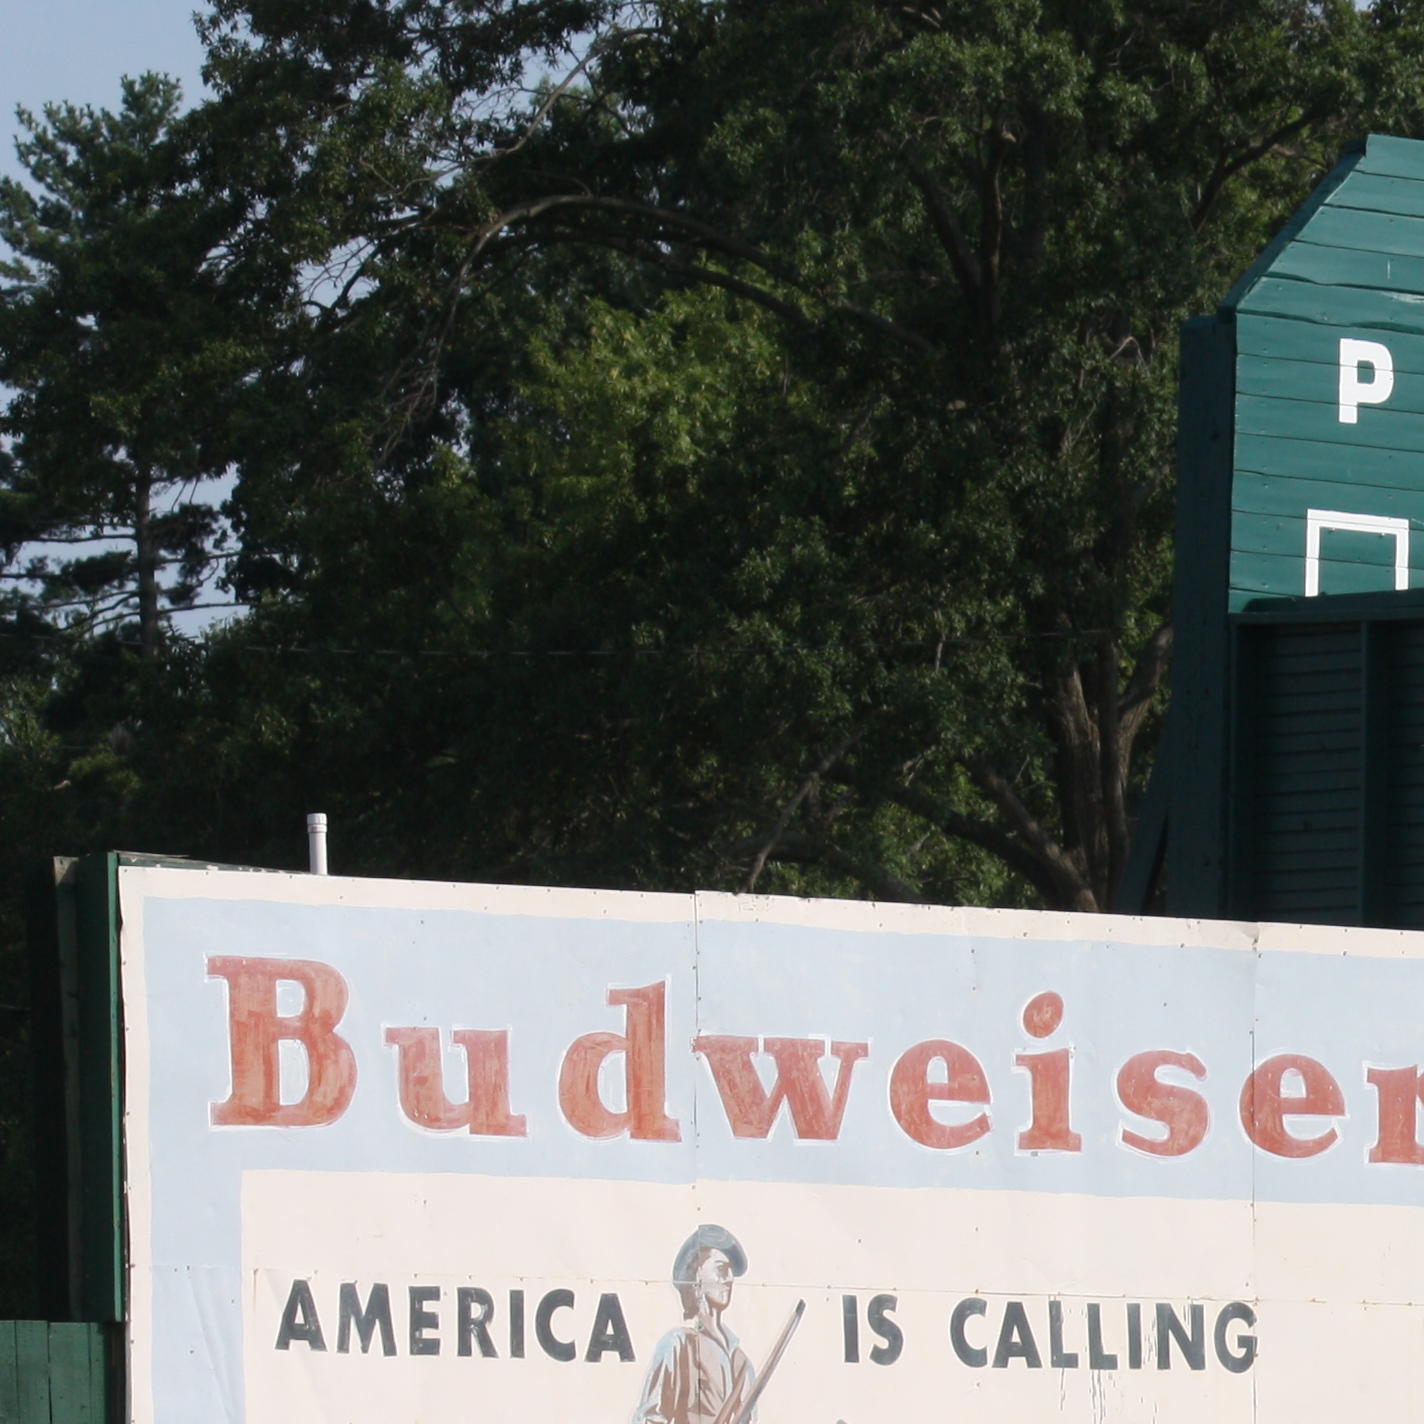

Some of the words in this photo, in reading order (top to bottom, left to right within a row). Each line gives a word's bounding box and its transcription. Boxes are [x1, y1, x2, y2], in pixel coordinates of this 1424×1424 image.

[1339, 338, 1394, 423] P
[276, 1280, 634, 1362] AMERICA
[843, 1295, 903, 1365] IS
[951, 1299, 1257, 1373] CALLING
